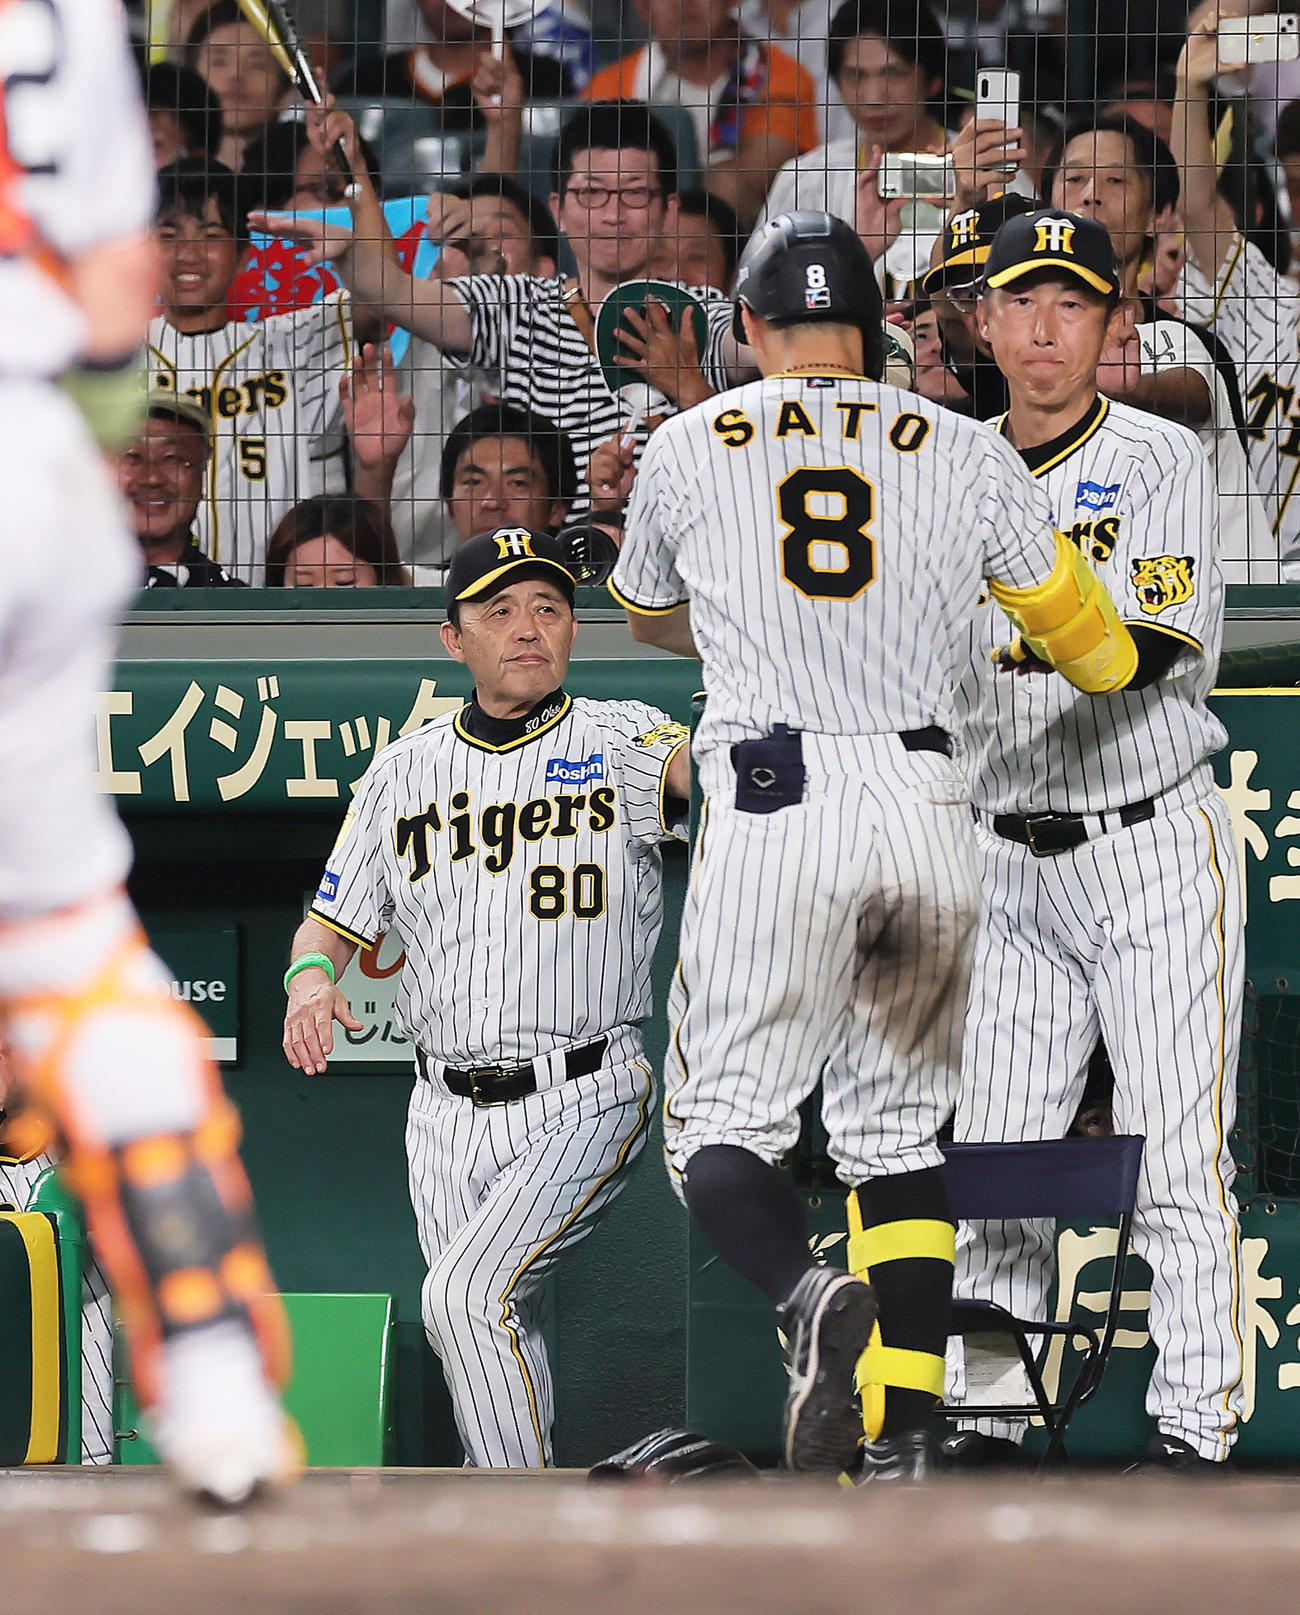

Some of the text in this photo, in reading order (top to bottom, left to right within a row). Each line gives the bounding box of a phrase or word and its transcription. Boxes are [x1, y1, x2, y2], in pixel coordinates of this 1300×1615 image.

[805, 263, 827, 289] 8
[713, 400, 932, 453] SATO
[239, 438, 267, 482] 5
[776, 464, 878, 603] 8
[395, 786, 617, 884] Tigers
[528, 862, 606, 921] 80
